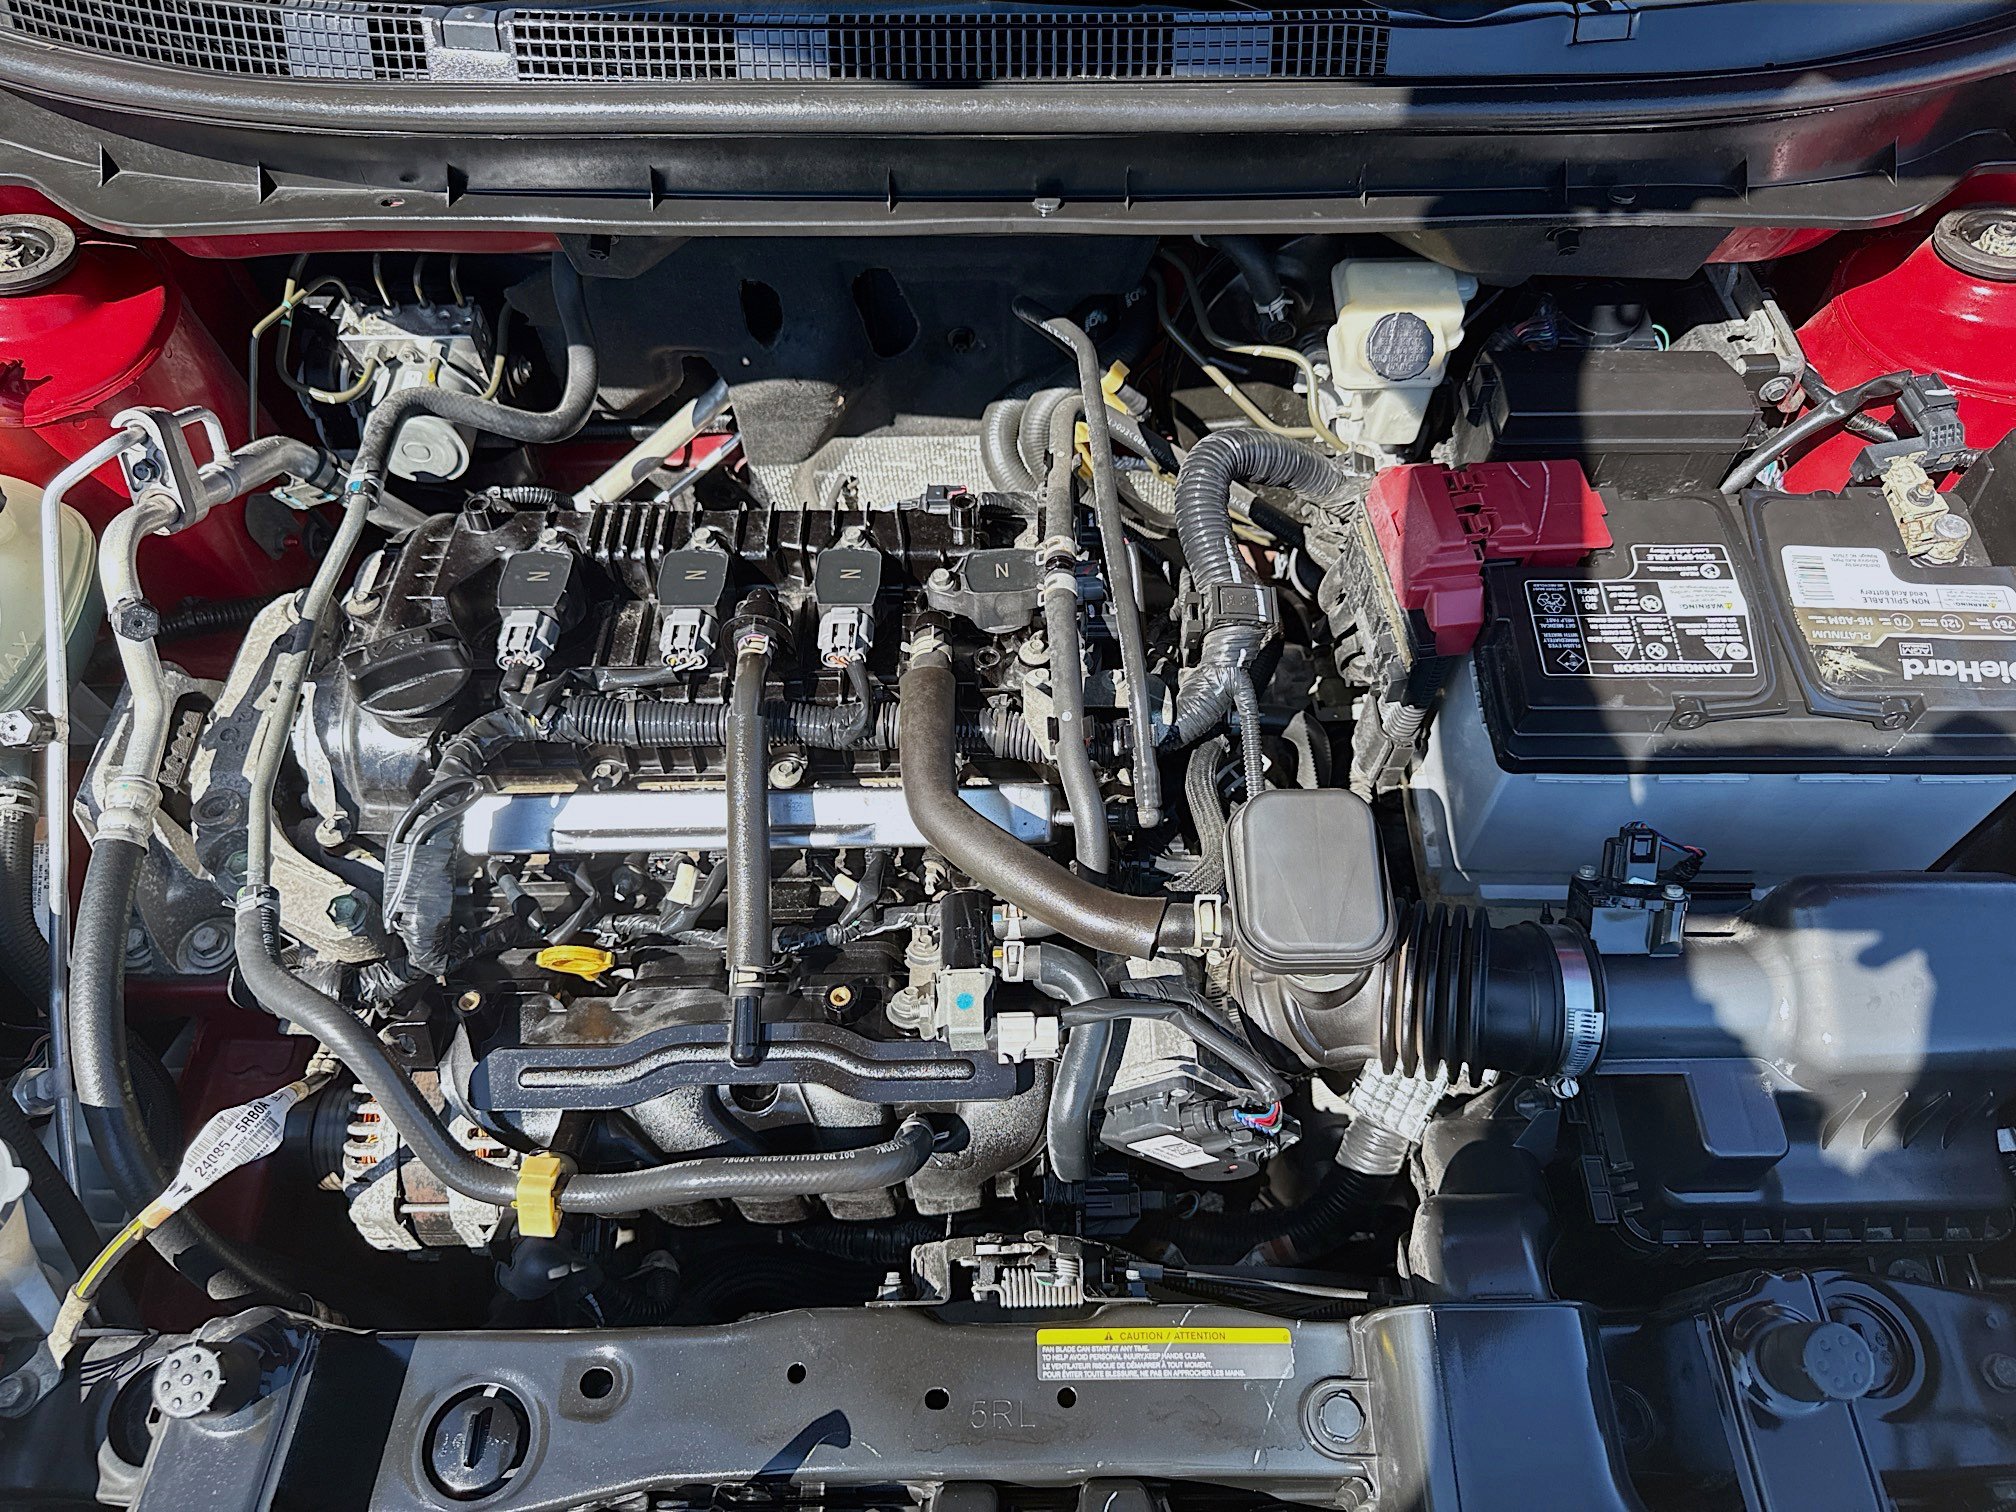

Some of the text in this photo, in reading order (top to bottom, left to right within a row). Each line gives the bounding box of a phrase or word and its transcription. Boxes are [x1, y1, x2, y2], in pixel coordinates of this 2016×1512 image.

[995, 562, 1010, 578] N
[1828, 616, 1873, 626] H6-AGM
[1894, 617, 1910, 627] 70
[1940, 618, 1961, 628] 120
[1992, 619, 2015, 629] 760
[1812, 630, 1870, 639] PLATINUM
[1902, 647, 1929, 655] AGM
[1613, 664, 1722, 673] DANGER/POISON
[232, 1136, 248, 1152] MADE
[254, 1110, 272, 1129] MEXICO
[840, 1151, 855, 1159] DOT
[1120, 1332, 1163, 1341] CAUTION
[1174, 1331, 1226, 1340] ATTENTION
[1042, 1345, 1054, 1353] FAN
[1056, 1345, 1076, 1353] BLADE
[1076, 1345, 1091, 1353] CAN
[1134, 1344, 1150, 1352] TIME.
[1162, 1352, 1184, 1360] HANDS
[1184, 1352, 1206, 1360] CLEAR.
[1042, 1362, 1050, 1370] LE
[1051, 1362, 1091, 1370] VENTILATEUR
[1092, 1362, 1116, 1370] RISQUE
[1126, 1360, 1160, 1369] DÉMARRER
[1042, 1370, 1061, 1379] POUR
[1062, 1369, 1082, 1378] ÉVITER
[1083, 1370, 1104, 1378] TOUTE
[1105, 1370, 1138, 1378] BLESSURE,
[1140, 1370, 1149, 1378] NE
[1150, 1370, 1162, 1378] PAS
[970, 1399, 1036, 1429] 5RL
